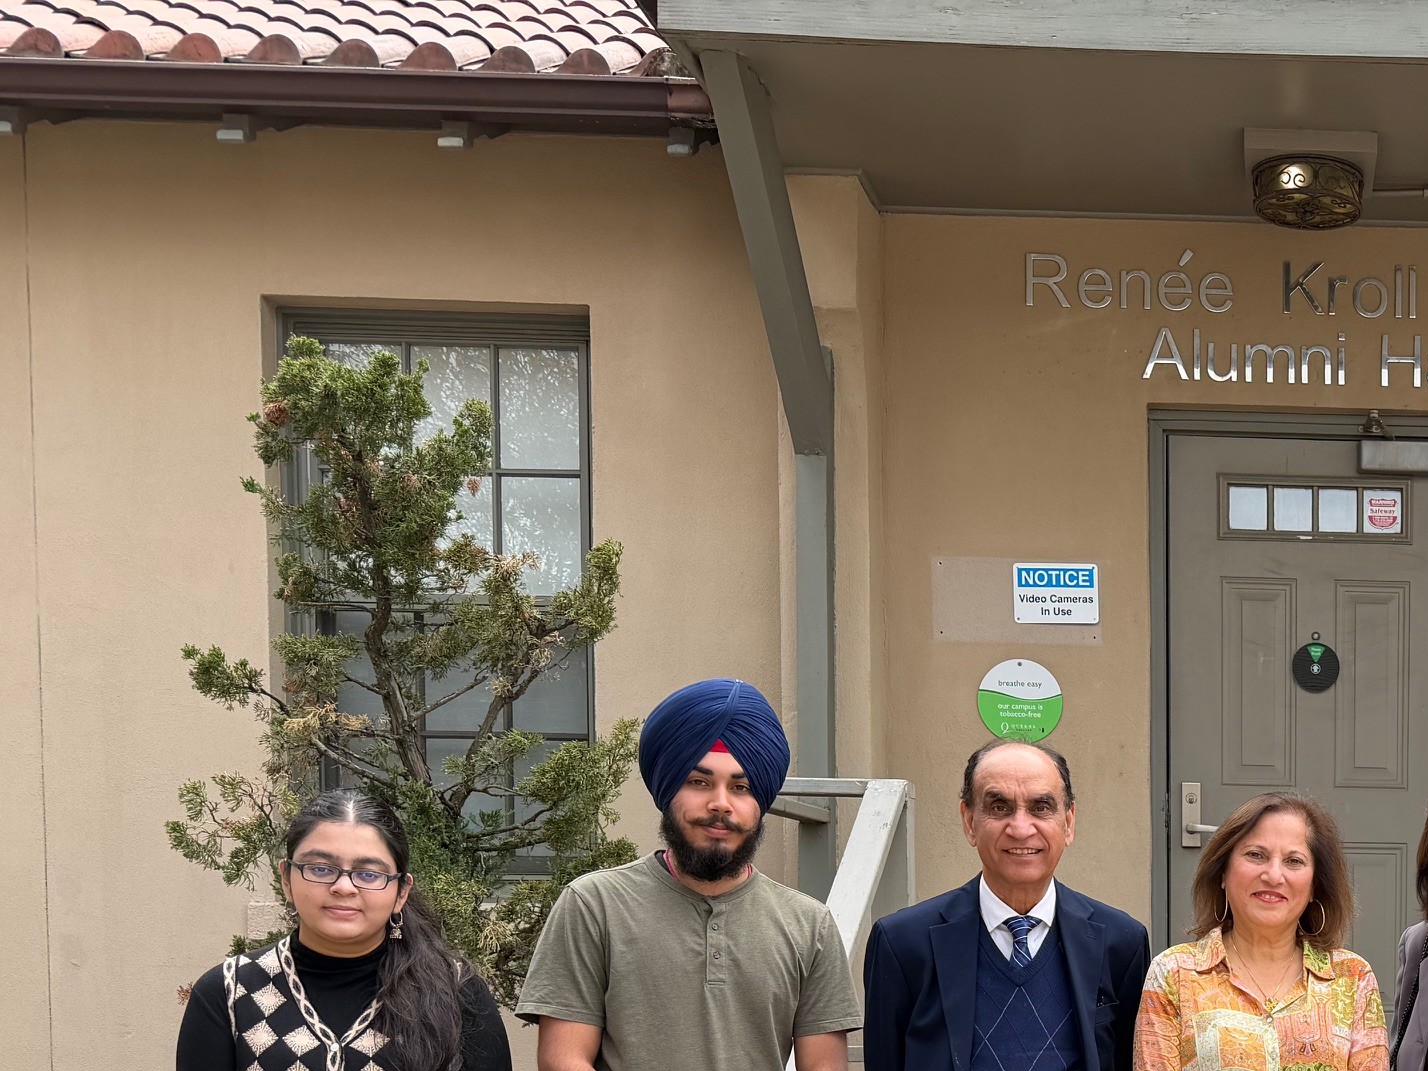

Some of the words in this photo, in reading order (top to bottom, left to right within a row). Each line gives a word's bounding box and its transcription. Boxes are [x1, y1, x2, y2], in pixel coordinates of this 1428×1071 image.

[1024, 248, 1235, 313] Renée
[1281, 260, 1418, 319] Kroll
[1141, 327, 1347, 386] Alumni
[1021, 570, 1090, 586] NOTICE
[1018, 594, 1047, 604] Video
[1049, 594, 1094, 604] Cameras
[1040, 607, 1050, 616] In
[1053, 607, 1073, 616] Use
[998, 679, 1025, 687] breathe
[1026, 681, 1043, 690] easy
[1011, 704, 1036, 712] campus
[1000, 710, 1042, 718] tobacco-free
